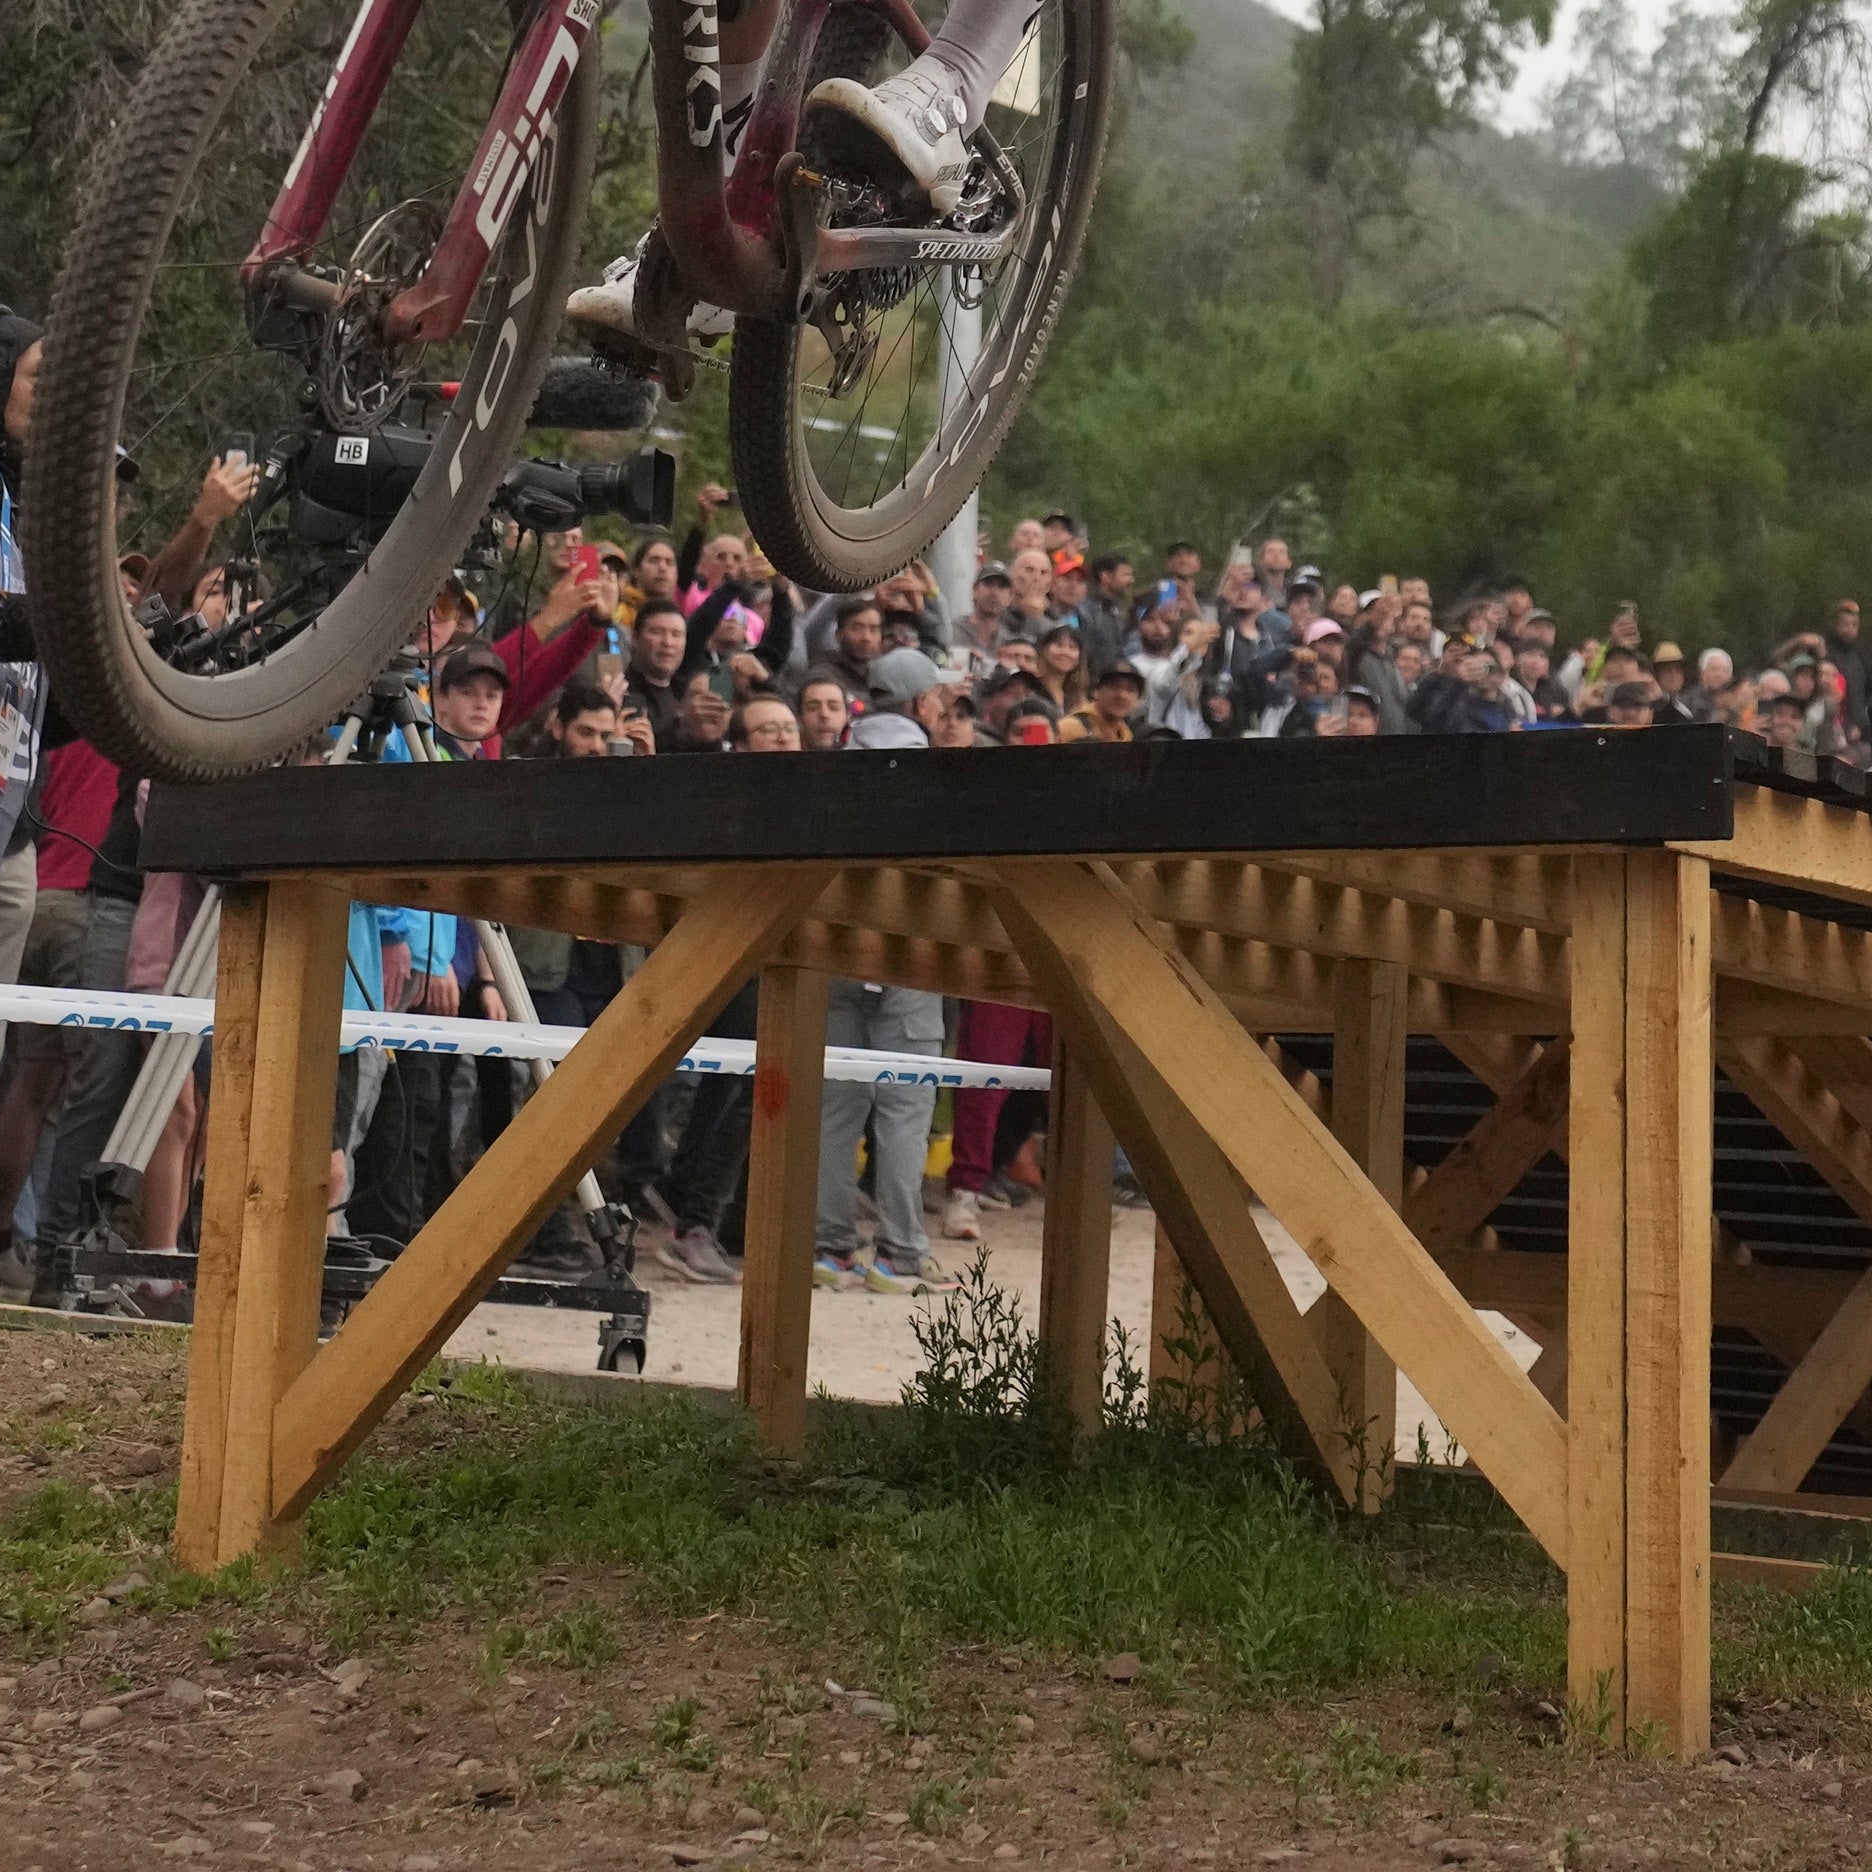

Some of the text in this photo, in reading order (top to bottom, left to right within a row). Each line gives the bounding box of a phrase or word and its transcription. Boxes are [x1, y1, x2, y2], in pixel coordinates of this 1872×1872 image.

[479, 137, 503, 186] ULTIMATE
[910, 241, 1003, 260] SPECIALIZED
[1016, 268, 1070, 385] RENEGADE
[339, 443, 363, 460] HB
